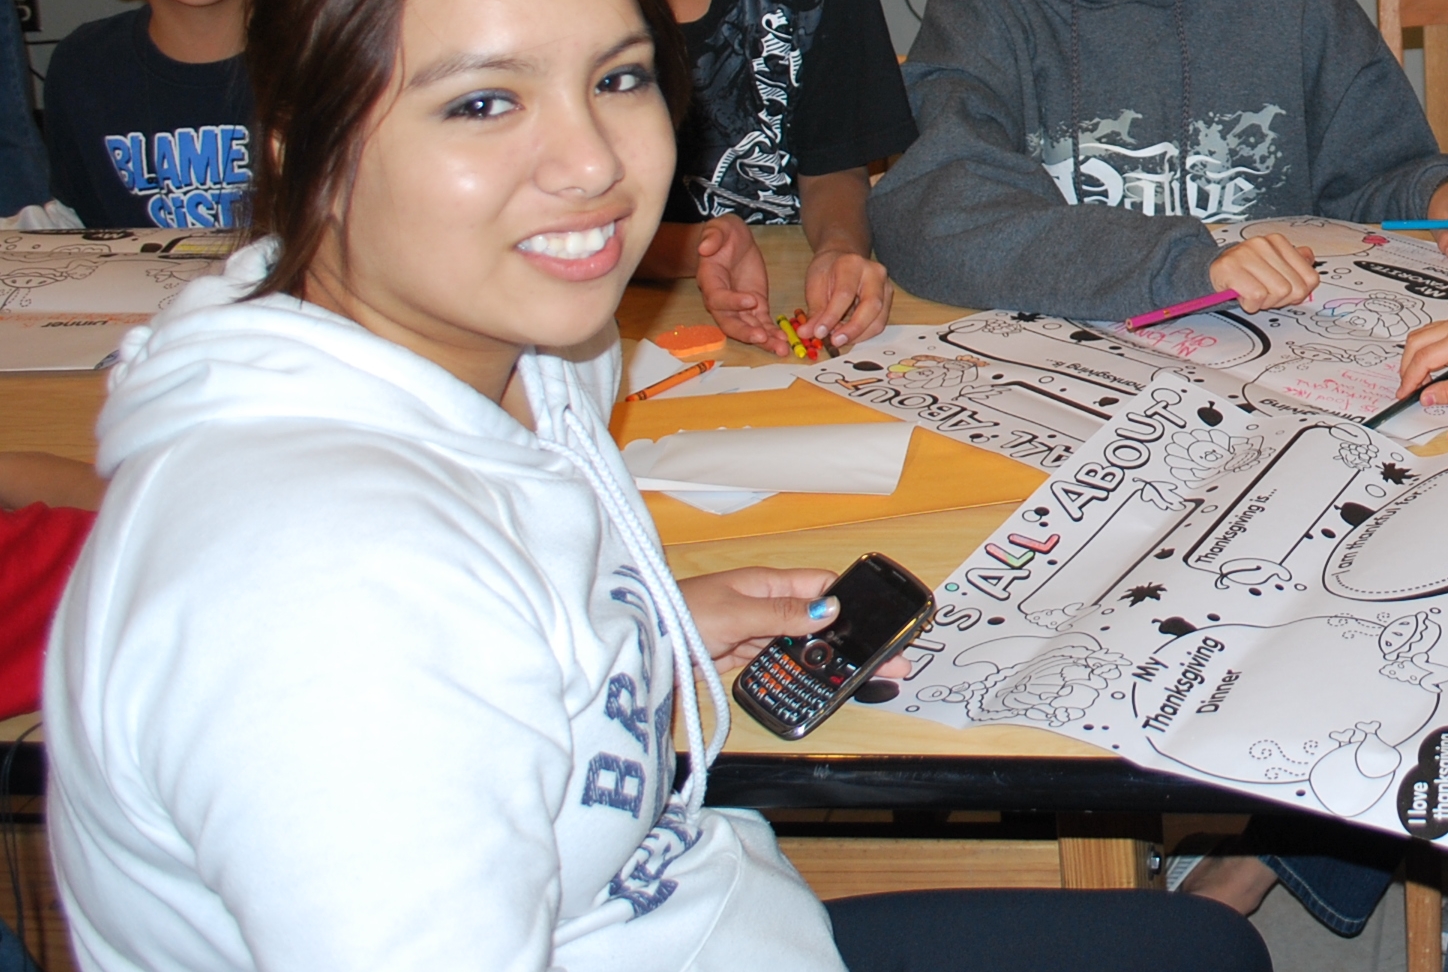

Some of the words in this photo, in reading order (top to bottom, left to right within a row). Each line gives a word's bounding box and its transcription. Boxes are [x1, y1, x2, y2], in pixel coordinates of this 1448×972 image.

[104, 124, 252, 196] BLAME
[1414, 286, 1447, 298] MY
[836, 376, 1000, 434] ABOUT
[965, 533, 1061, 601] ALL
[1050, 400, 1188, 522] ABOUT
[1194, 503, 1266, 564] Thanksgiving
[1345, 508, 1402, 551] thankful
[1338, 551, 1359, 569] am
[1131, 656, 1169, 683] My
[1141, 635, 1226, 733] Thanksgiving
[1195, 669, 1243, 714] Dinner
[1407, 781, 1430, 815] love
